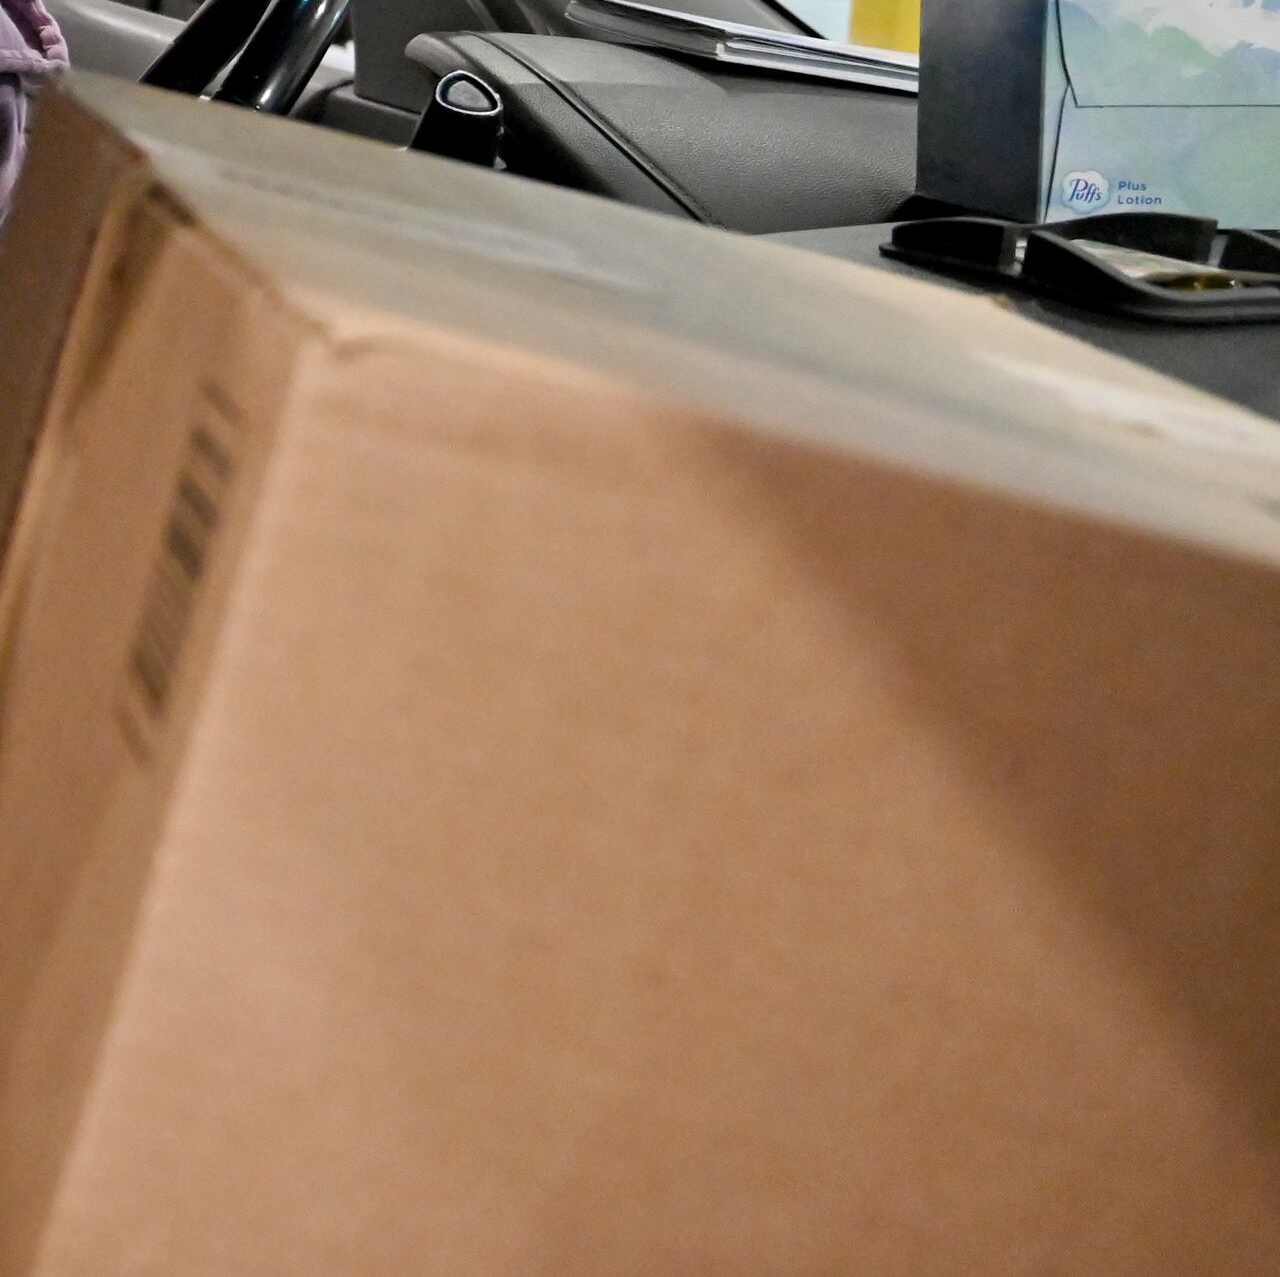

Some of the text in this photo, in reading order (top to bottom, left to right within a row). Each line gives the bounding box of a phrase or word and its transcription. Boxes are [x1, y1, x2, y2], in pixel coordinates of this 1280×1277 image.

[1069, 178, 1102, 203] Puffs
[1118, 181, 1147, 191] Plus
[1117, 195, 1162, 205] Lotion
